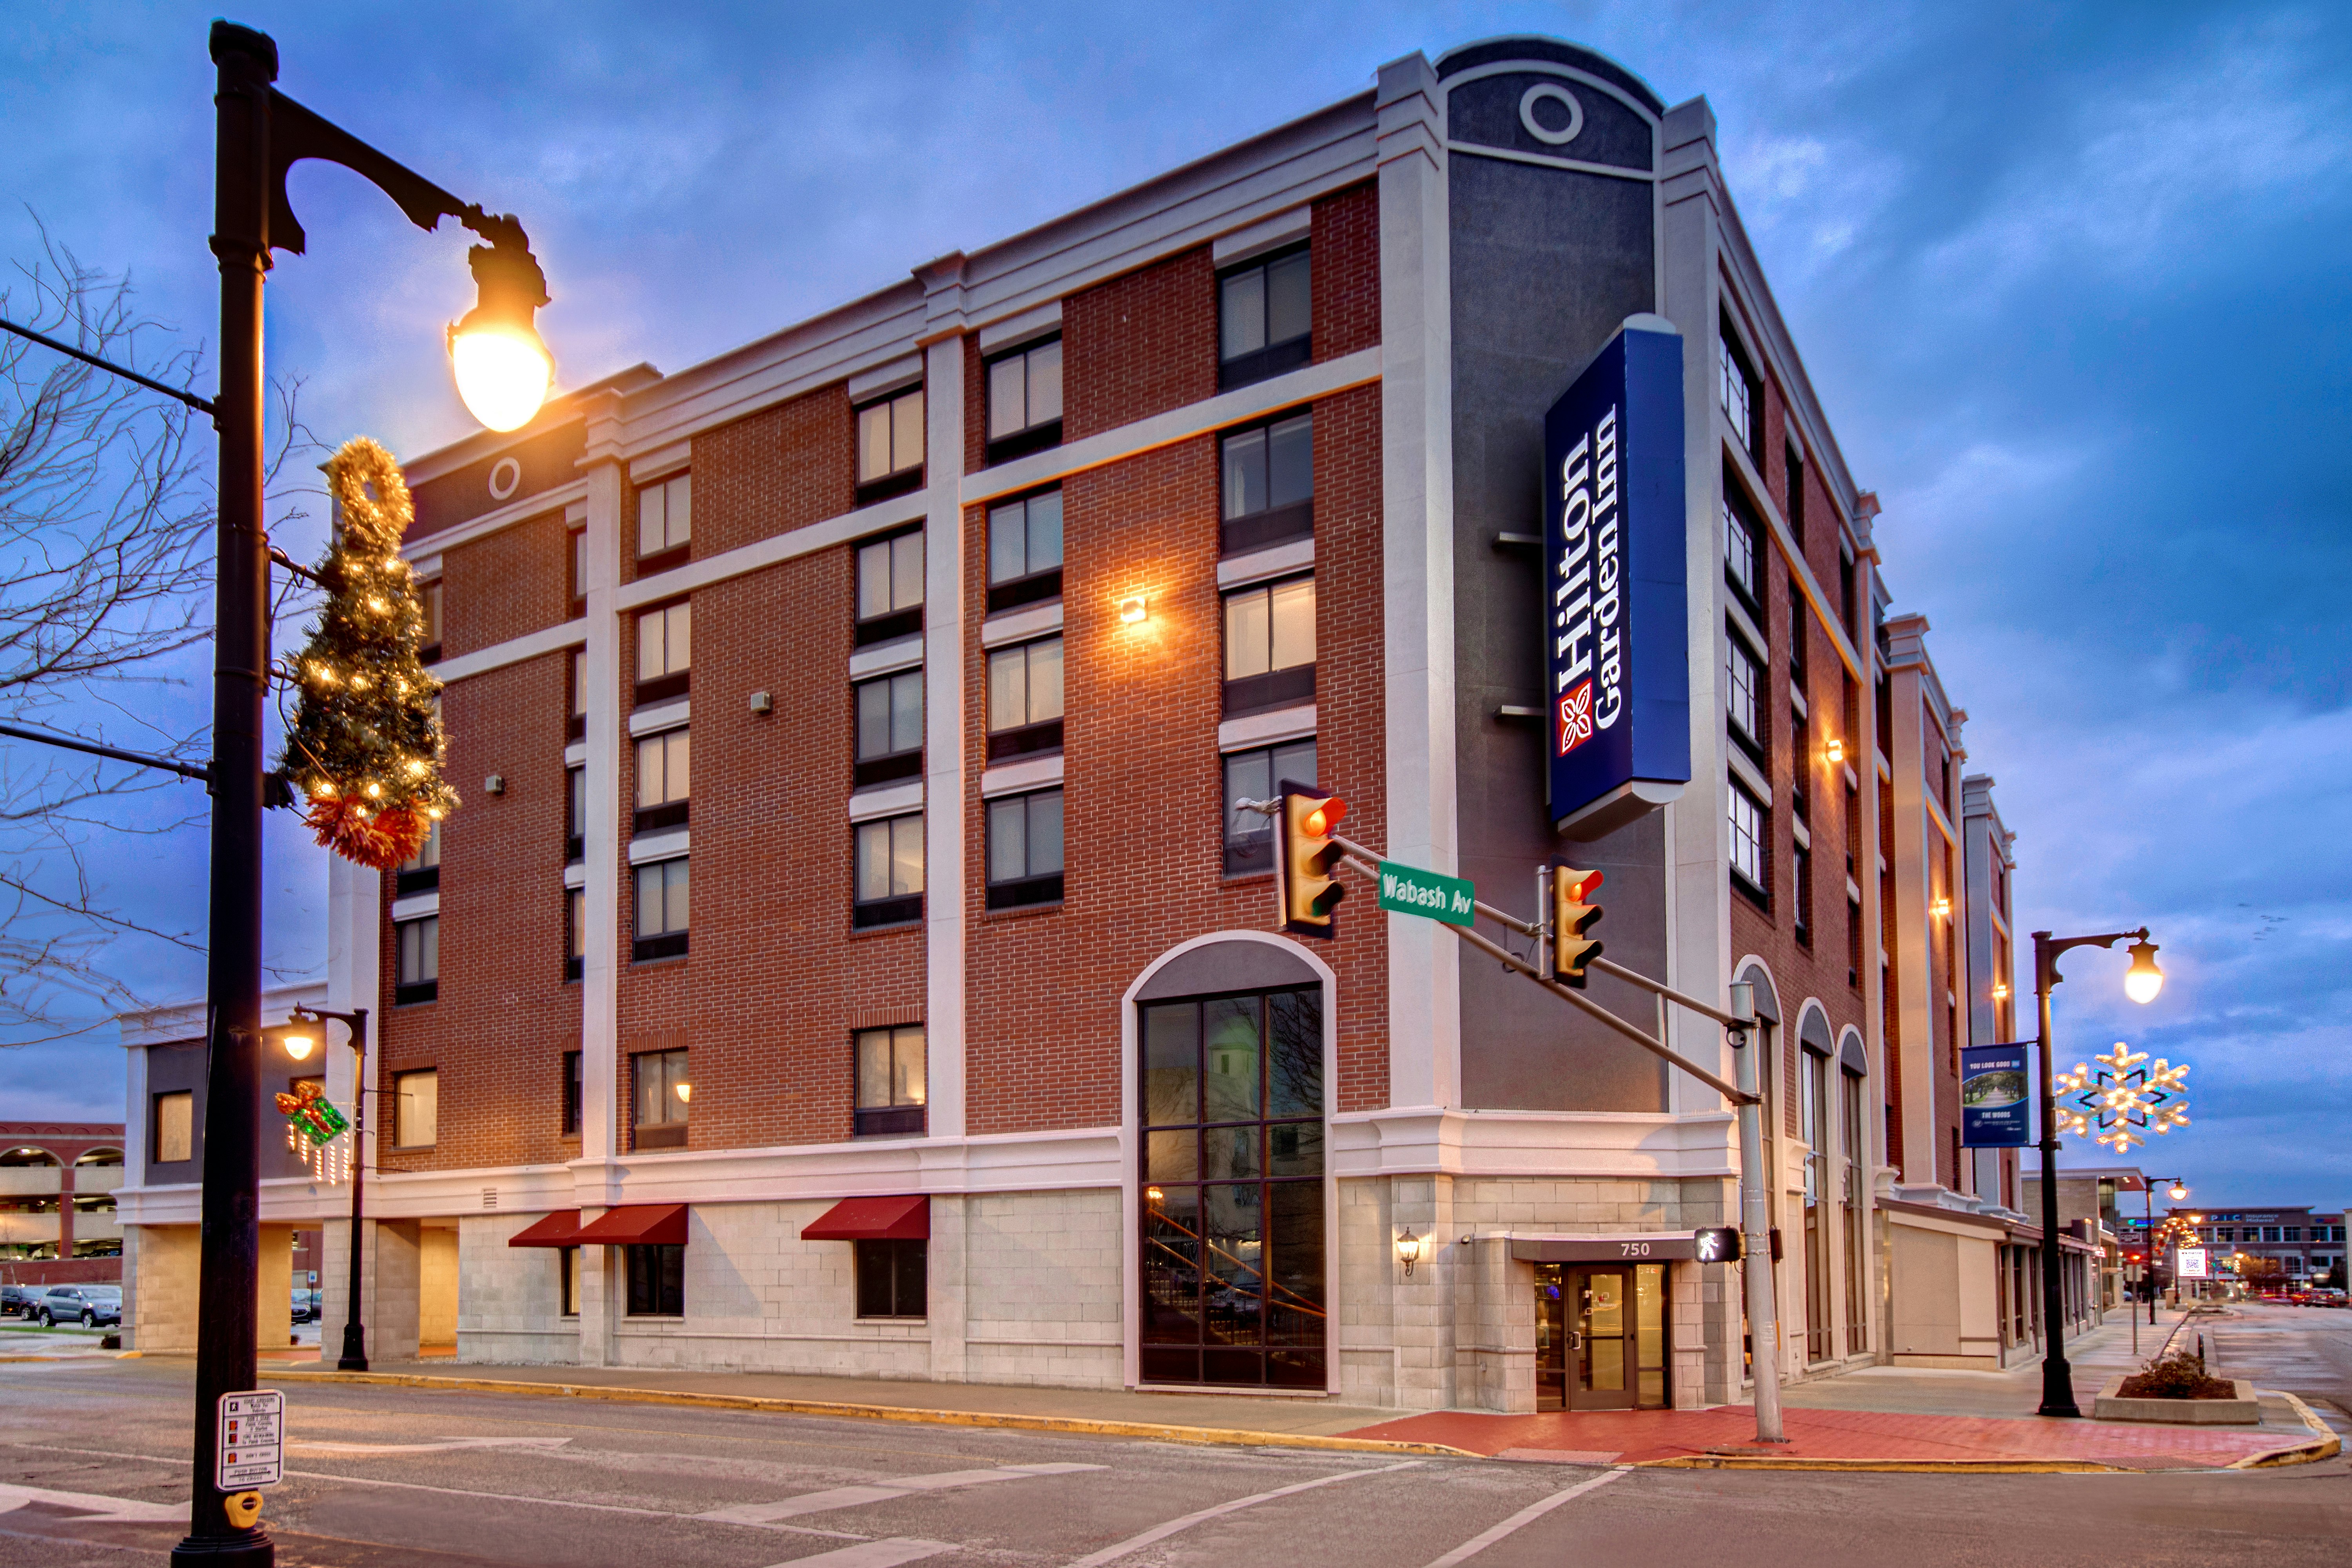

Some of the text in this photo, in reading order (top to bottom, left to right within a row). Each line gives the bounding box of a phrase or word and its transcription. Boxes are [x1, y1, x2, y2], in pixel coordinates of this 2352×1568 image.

[1556, 432, 1592, 693] Hilton
[1592, 403, 1622, 730] Garden Inn
[1383, 873, 1472, 915] Wabash Av
[1621, 1242, 1650, 1256] 750
